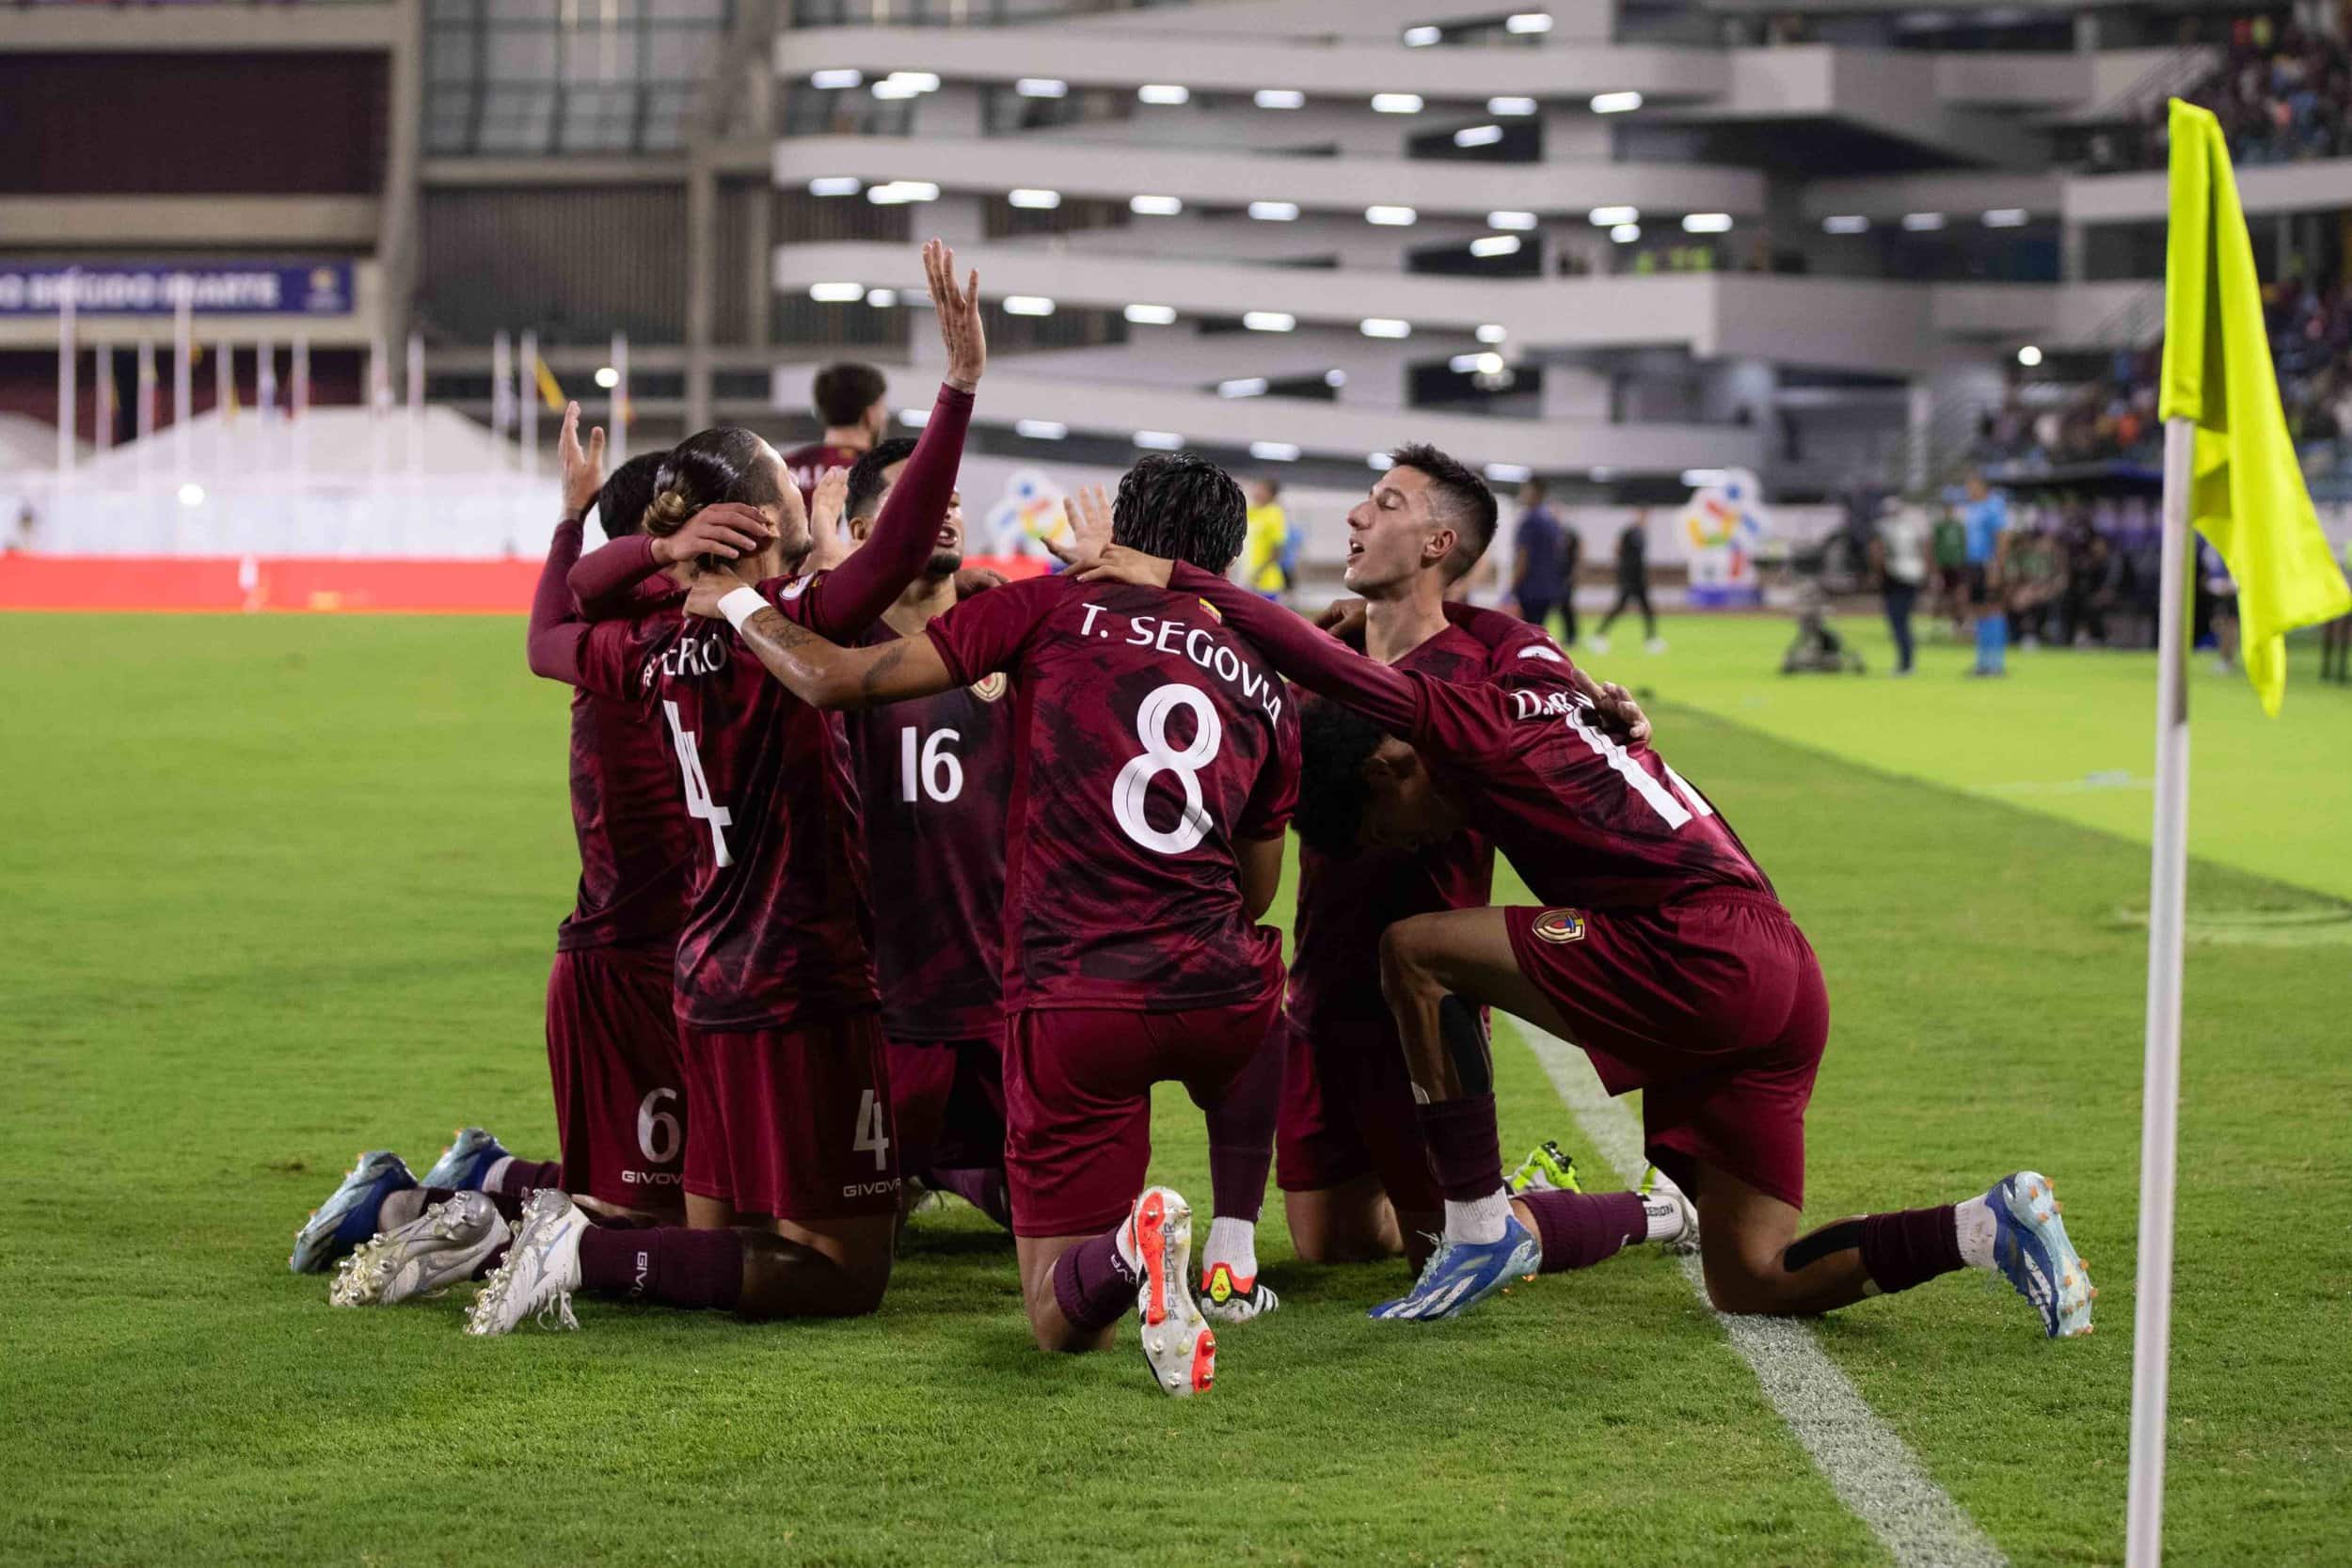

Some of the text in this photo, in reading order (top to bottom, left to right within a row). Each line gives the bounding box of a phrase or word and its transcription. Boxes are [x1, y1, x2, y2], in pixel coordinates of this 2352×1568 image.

[1080, 602, 1109, 640] T.
[663, 699, 735, 868] 4
[900, 725, 965, 803] 16
[1112, 683, 1222, 854] 8
[637, 1087, 681, 1164] 6
[852, 1088, 890, 1171] 4
